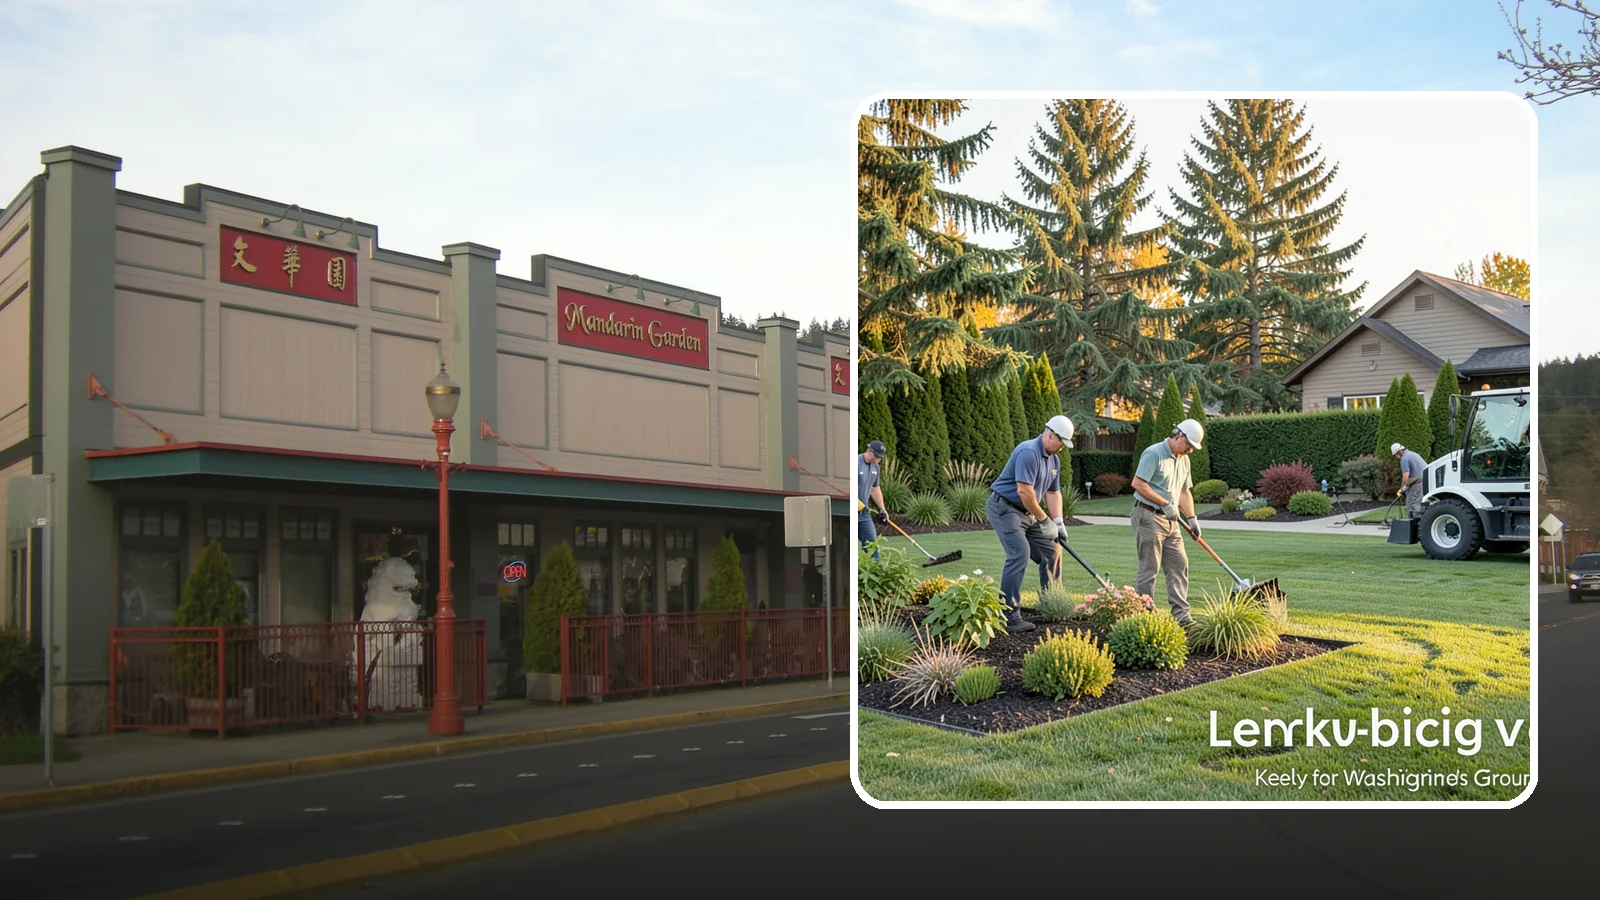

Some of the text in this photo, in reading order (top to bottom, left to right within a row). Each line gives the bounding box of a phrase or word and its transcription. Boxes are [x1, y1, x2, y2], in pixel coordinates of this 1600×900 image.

[564, 302, 701, 352] Mandarin Garden
[503, 565, 527, 578] OPEN
